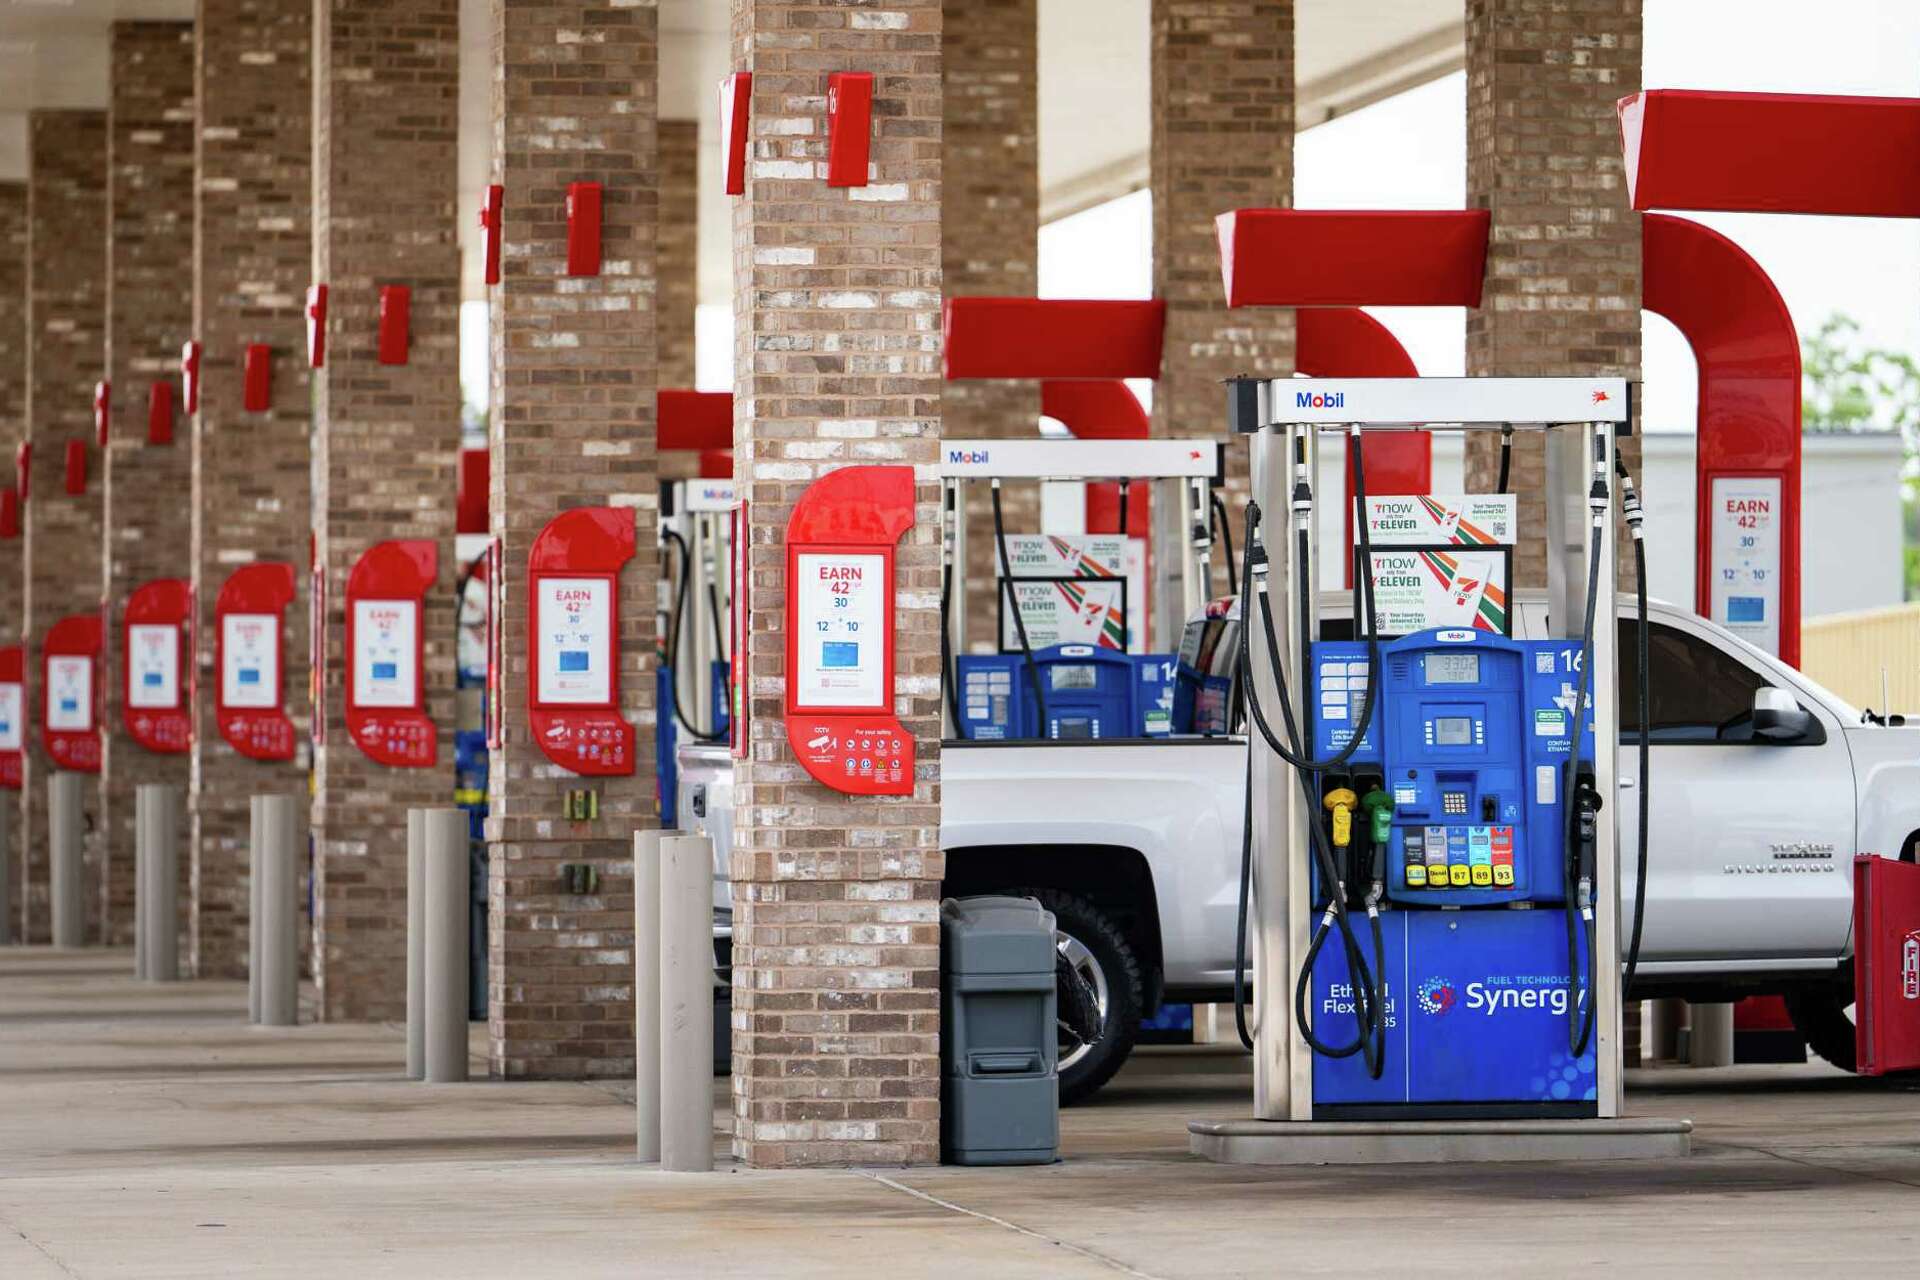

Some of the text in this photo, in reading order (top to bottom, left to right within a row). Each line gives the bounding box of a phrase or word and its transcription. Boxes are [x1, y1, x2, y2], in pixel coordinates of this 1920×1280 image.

[1297, 392, 1343, 408] Mobil
[950, 451, 988, 463] Mobil
[1727, 501, 1769, 512] EARN
[1738, 516, 1756, 528] 42
[1741, 537, 1754, 547] 30
[819, 567, 862, 580] EARN
[1723, 570, 1735, 580] 12
[1753, 570, 1765, 580] 10
[831, 582, 849, 594] 42
[556, 590, 591, 600] EARN
[566, 603, 580, 612] 42
[834, 598, 848, 607] 30
[817, 622, 829, 631] 12
[847, 622, 859, 631] 10
[1561, 650, 1585, 672] 16
[1723, 863, 1834, 874] SILVERADO
[1454, 872, 1466, 880] 87
[1476, 872, 1488, 880] 89
[1907, 947, 1917, 994] FIRE
[1516, 976, 1586, 984] TECHNOLOY
[1330, 984, 1389, 998] Ethl
[1323, 999, 1395, 1013] Flex Fel
